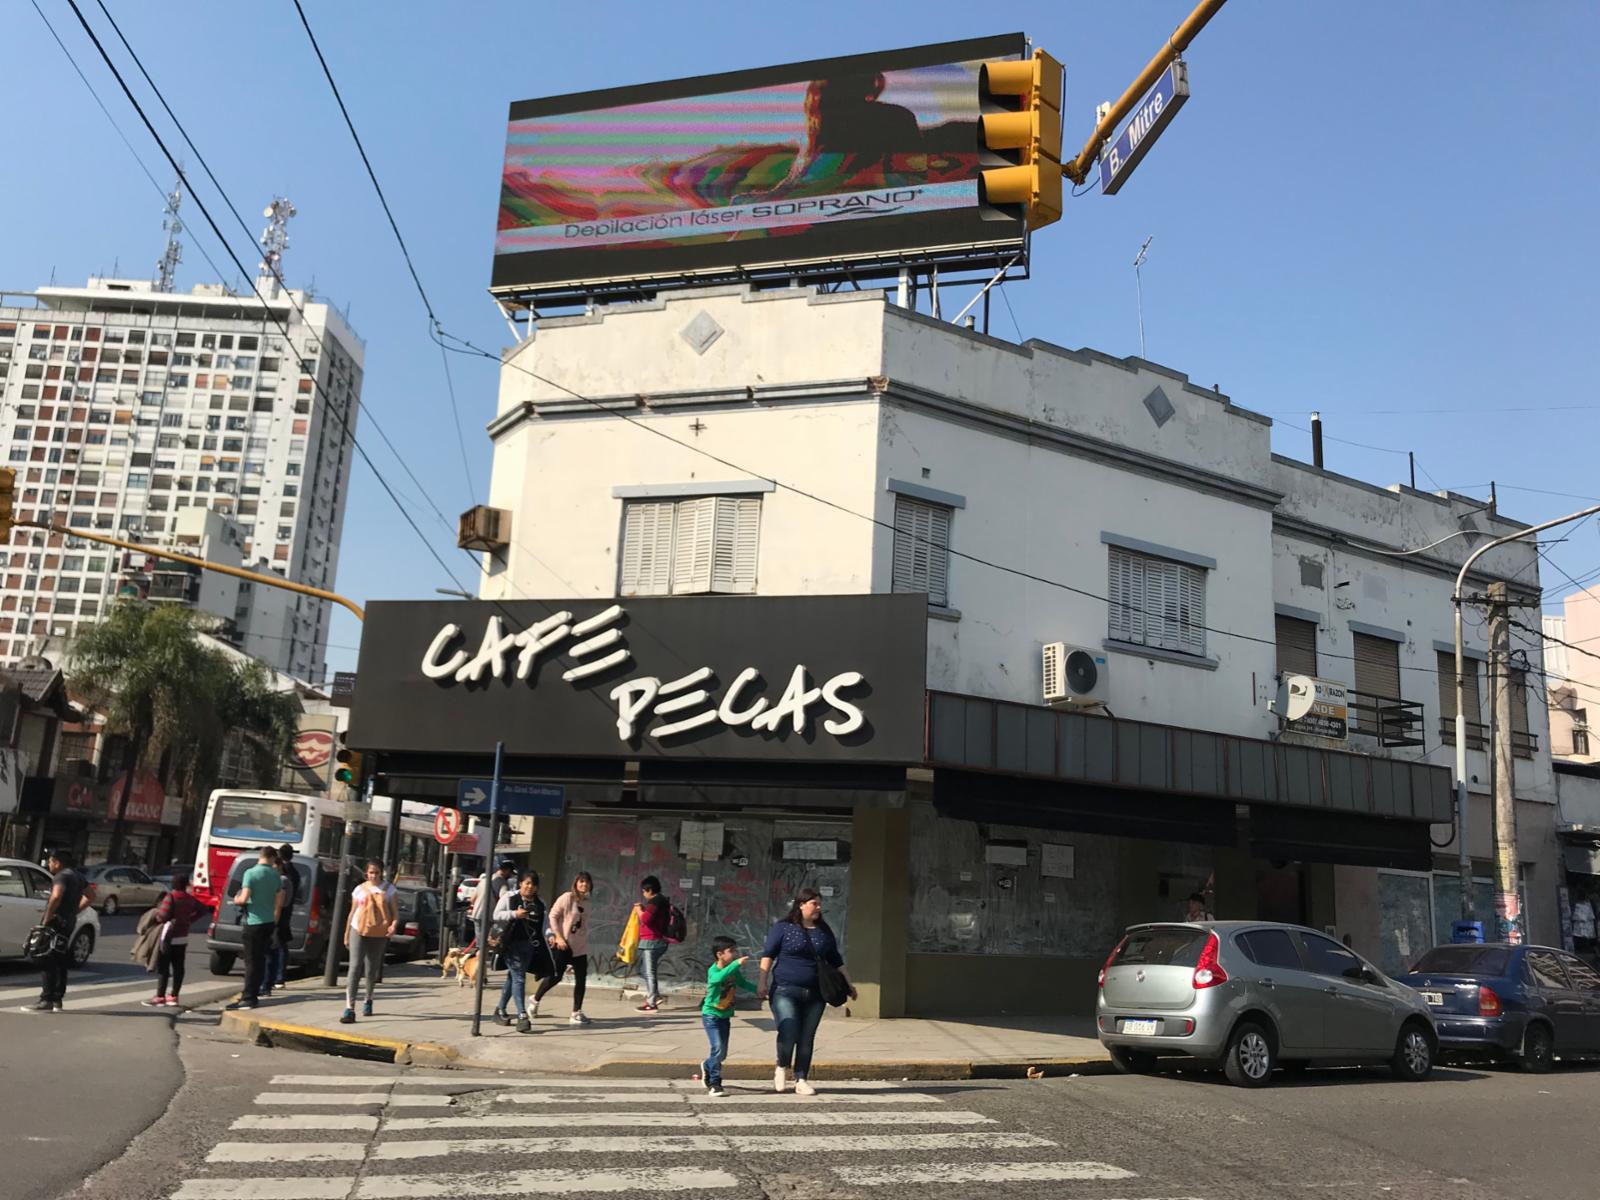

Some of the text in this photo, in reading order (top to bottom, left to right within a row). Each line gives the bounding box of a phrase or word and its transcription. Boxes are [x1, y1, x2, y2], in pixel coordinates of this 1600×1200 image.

[1109, 92, 1163, 177] B. Mitre
[564, 213, 682, 239] Depilación
[690, 209, 743, 227] láser
[421, 605, 630, 682] CAFE
[610, 664, 865, 741] PECAS
